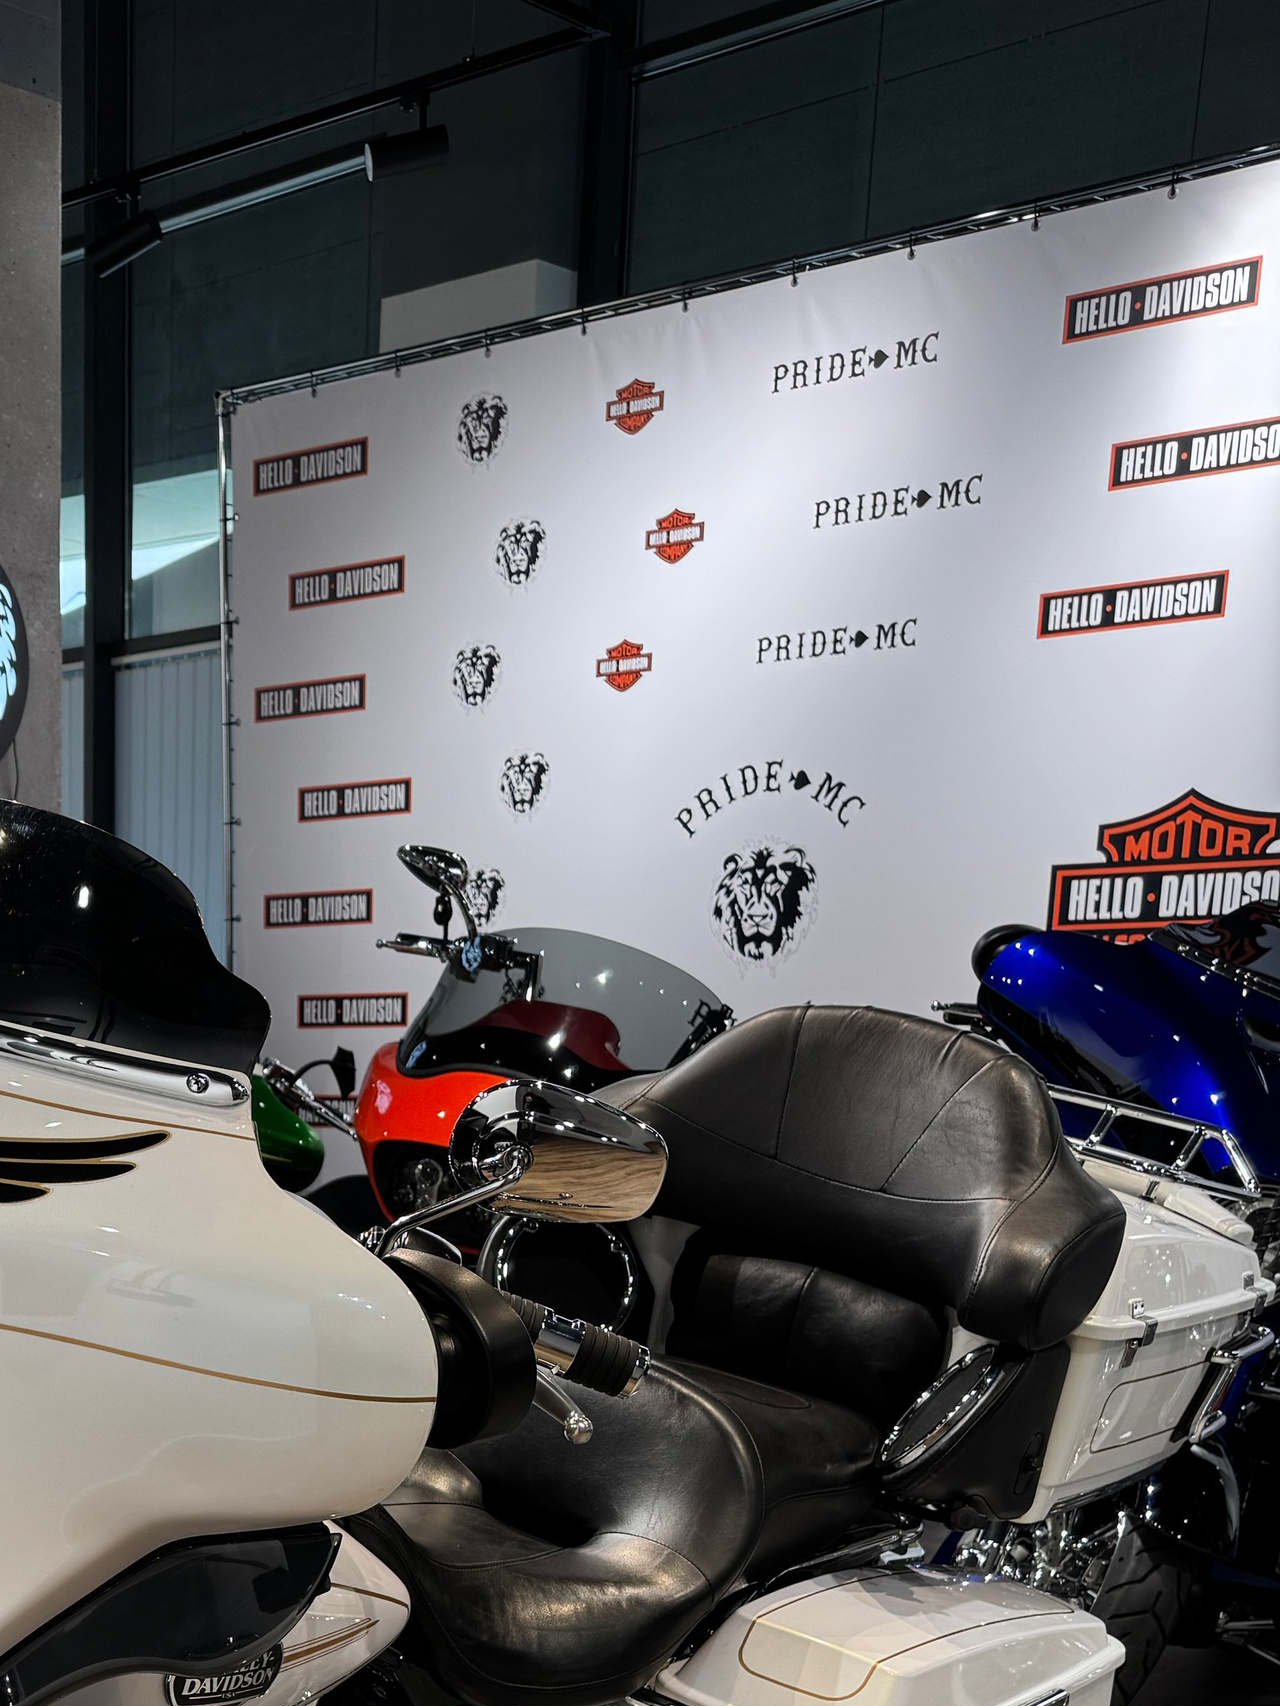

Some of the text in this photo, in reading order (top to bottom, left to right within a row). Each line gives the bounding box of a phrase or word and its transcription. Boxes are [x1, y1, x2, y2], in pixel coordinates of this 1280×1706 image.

[1074, 265, 1251, 335] HELLO DAVIDSON
[771, 331, 940, 394] PRIDE MC
[259, 444, 362, 490] HELLO DAVIDSON
[1119, 440, 1178, 482] HELLO
[813, 474, 984, 529] PRIDE MC
[295, 562, 399, 604] HELLO DAVIDSON
[1047, 578, 1218, 631] HELLO DAVIDSON
[756, 617, 918, 664] PRIDE MC
[261, 680, 360, 716] HELLO DAVIDSON
[303, 783, 406, 817] HELLO DAVIDSON
[674, 759, 867, 838] PRIDE MC
[1123, 809, 1252, 862] MOTOR
[270, 894, 367, 923] HELLO DAVIDSON
[1067, 876, 1144, 922] HELLO
[304, 997, 402, 1023] HELLO DAVIDSON
[181, 1666, 276, 1696] DAVIDSON
